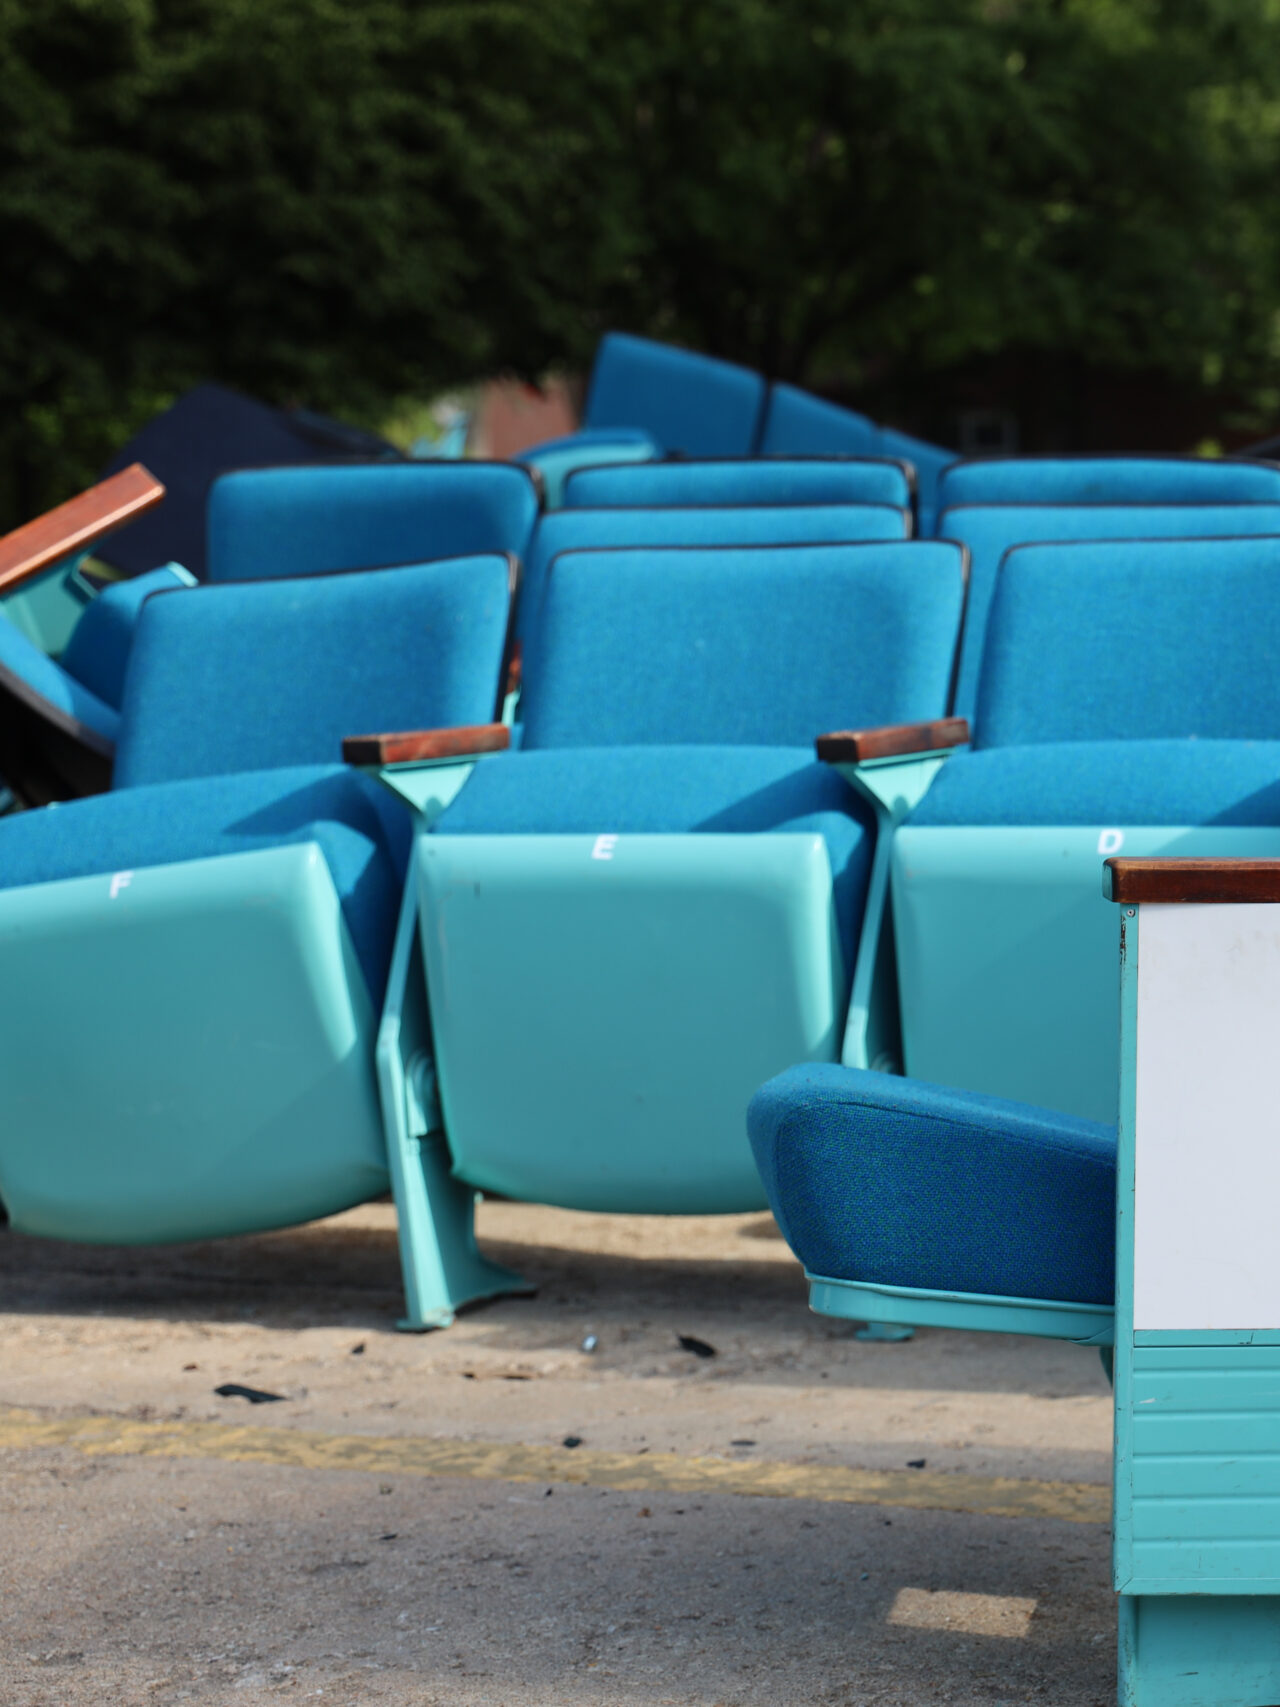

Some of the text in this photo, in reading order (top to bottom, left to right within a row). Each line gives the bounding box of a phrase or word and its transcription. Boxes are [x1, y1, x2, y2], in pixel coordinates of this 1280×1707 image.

[592, 833, 619, 860] E
[1098, 828, 1124, 855] D
[110, 870, 134, 899] F
